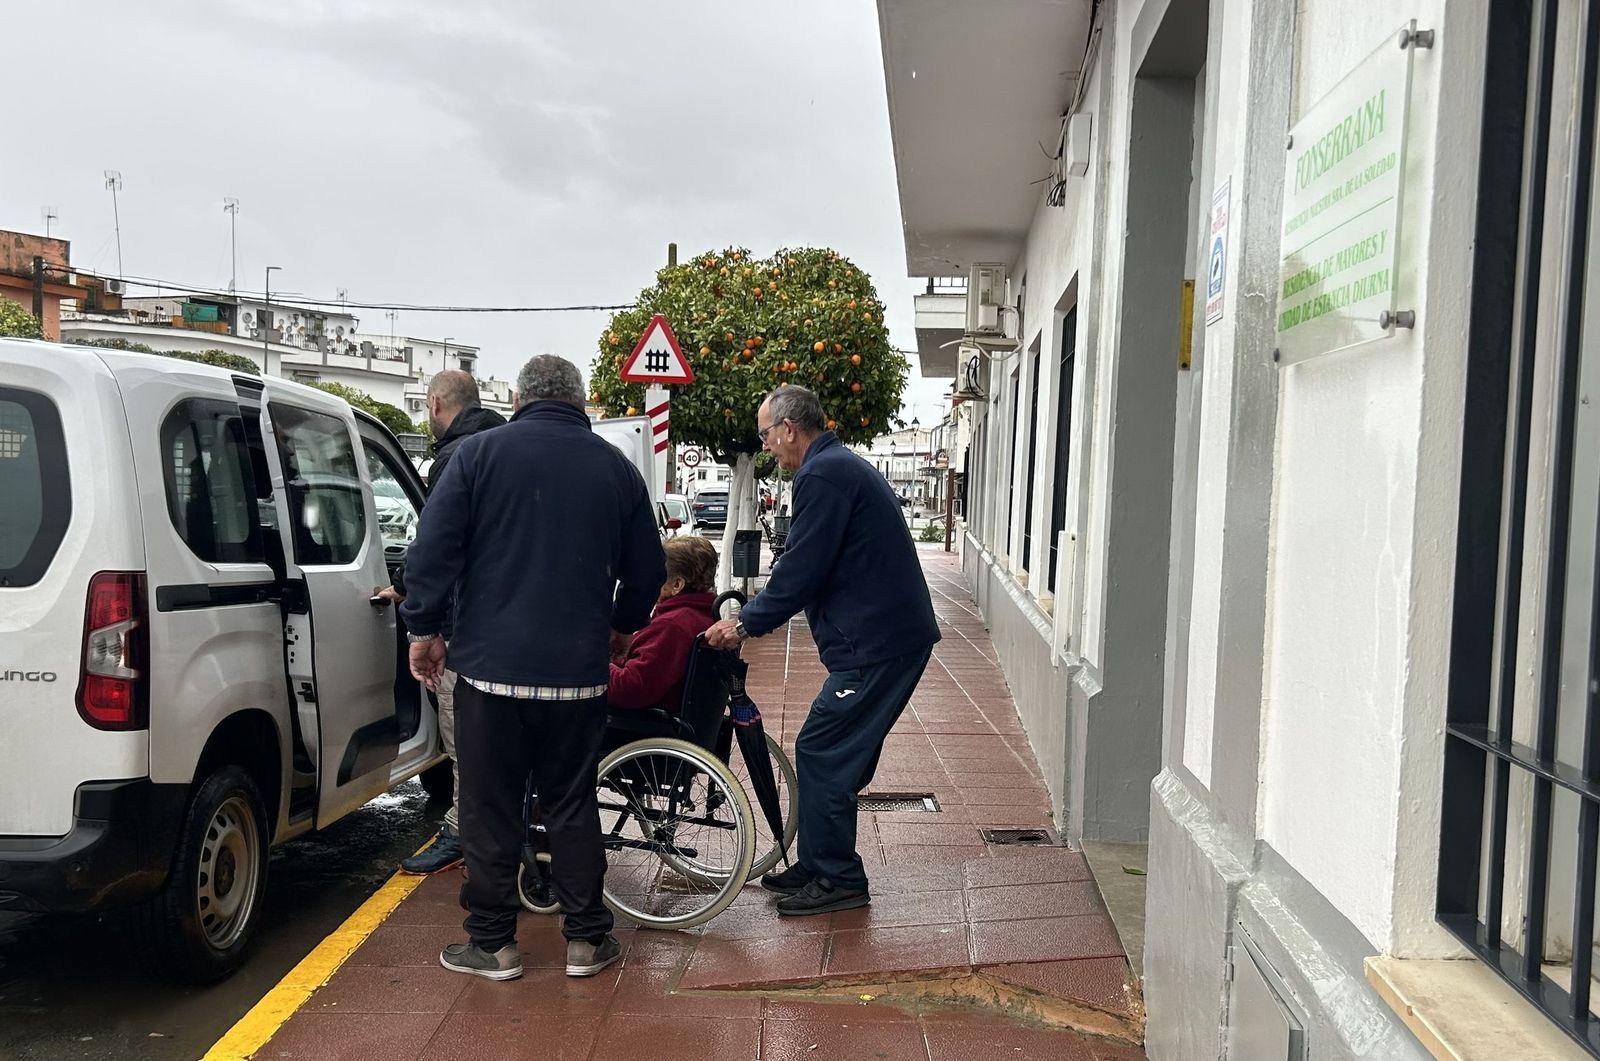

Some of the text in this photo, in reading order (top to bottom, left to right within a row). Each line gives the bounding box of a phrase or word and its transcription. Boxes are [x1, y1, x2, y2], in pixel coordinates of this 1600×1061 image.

[1294, 89, 1385, 196] FONSERRANA
[1344, 177, 1355, 197] DE
[1363, 152, 1396, 185] SOLEDAD
[1322, 255, 1334, 281] DE
[1335, 234, 1378, 273] MAYORES
[1379, 229, 1388, 254] Y
[1301, 300, 1312, 324] DE
[1312, 284, 1351, 319] ESTANCIA
[1352, 269, 1388, 303] DIURNA
[686, 454, 697, 462] 40
